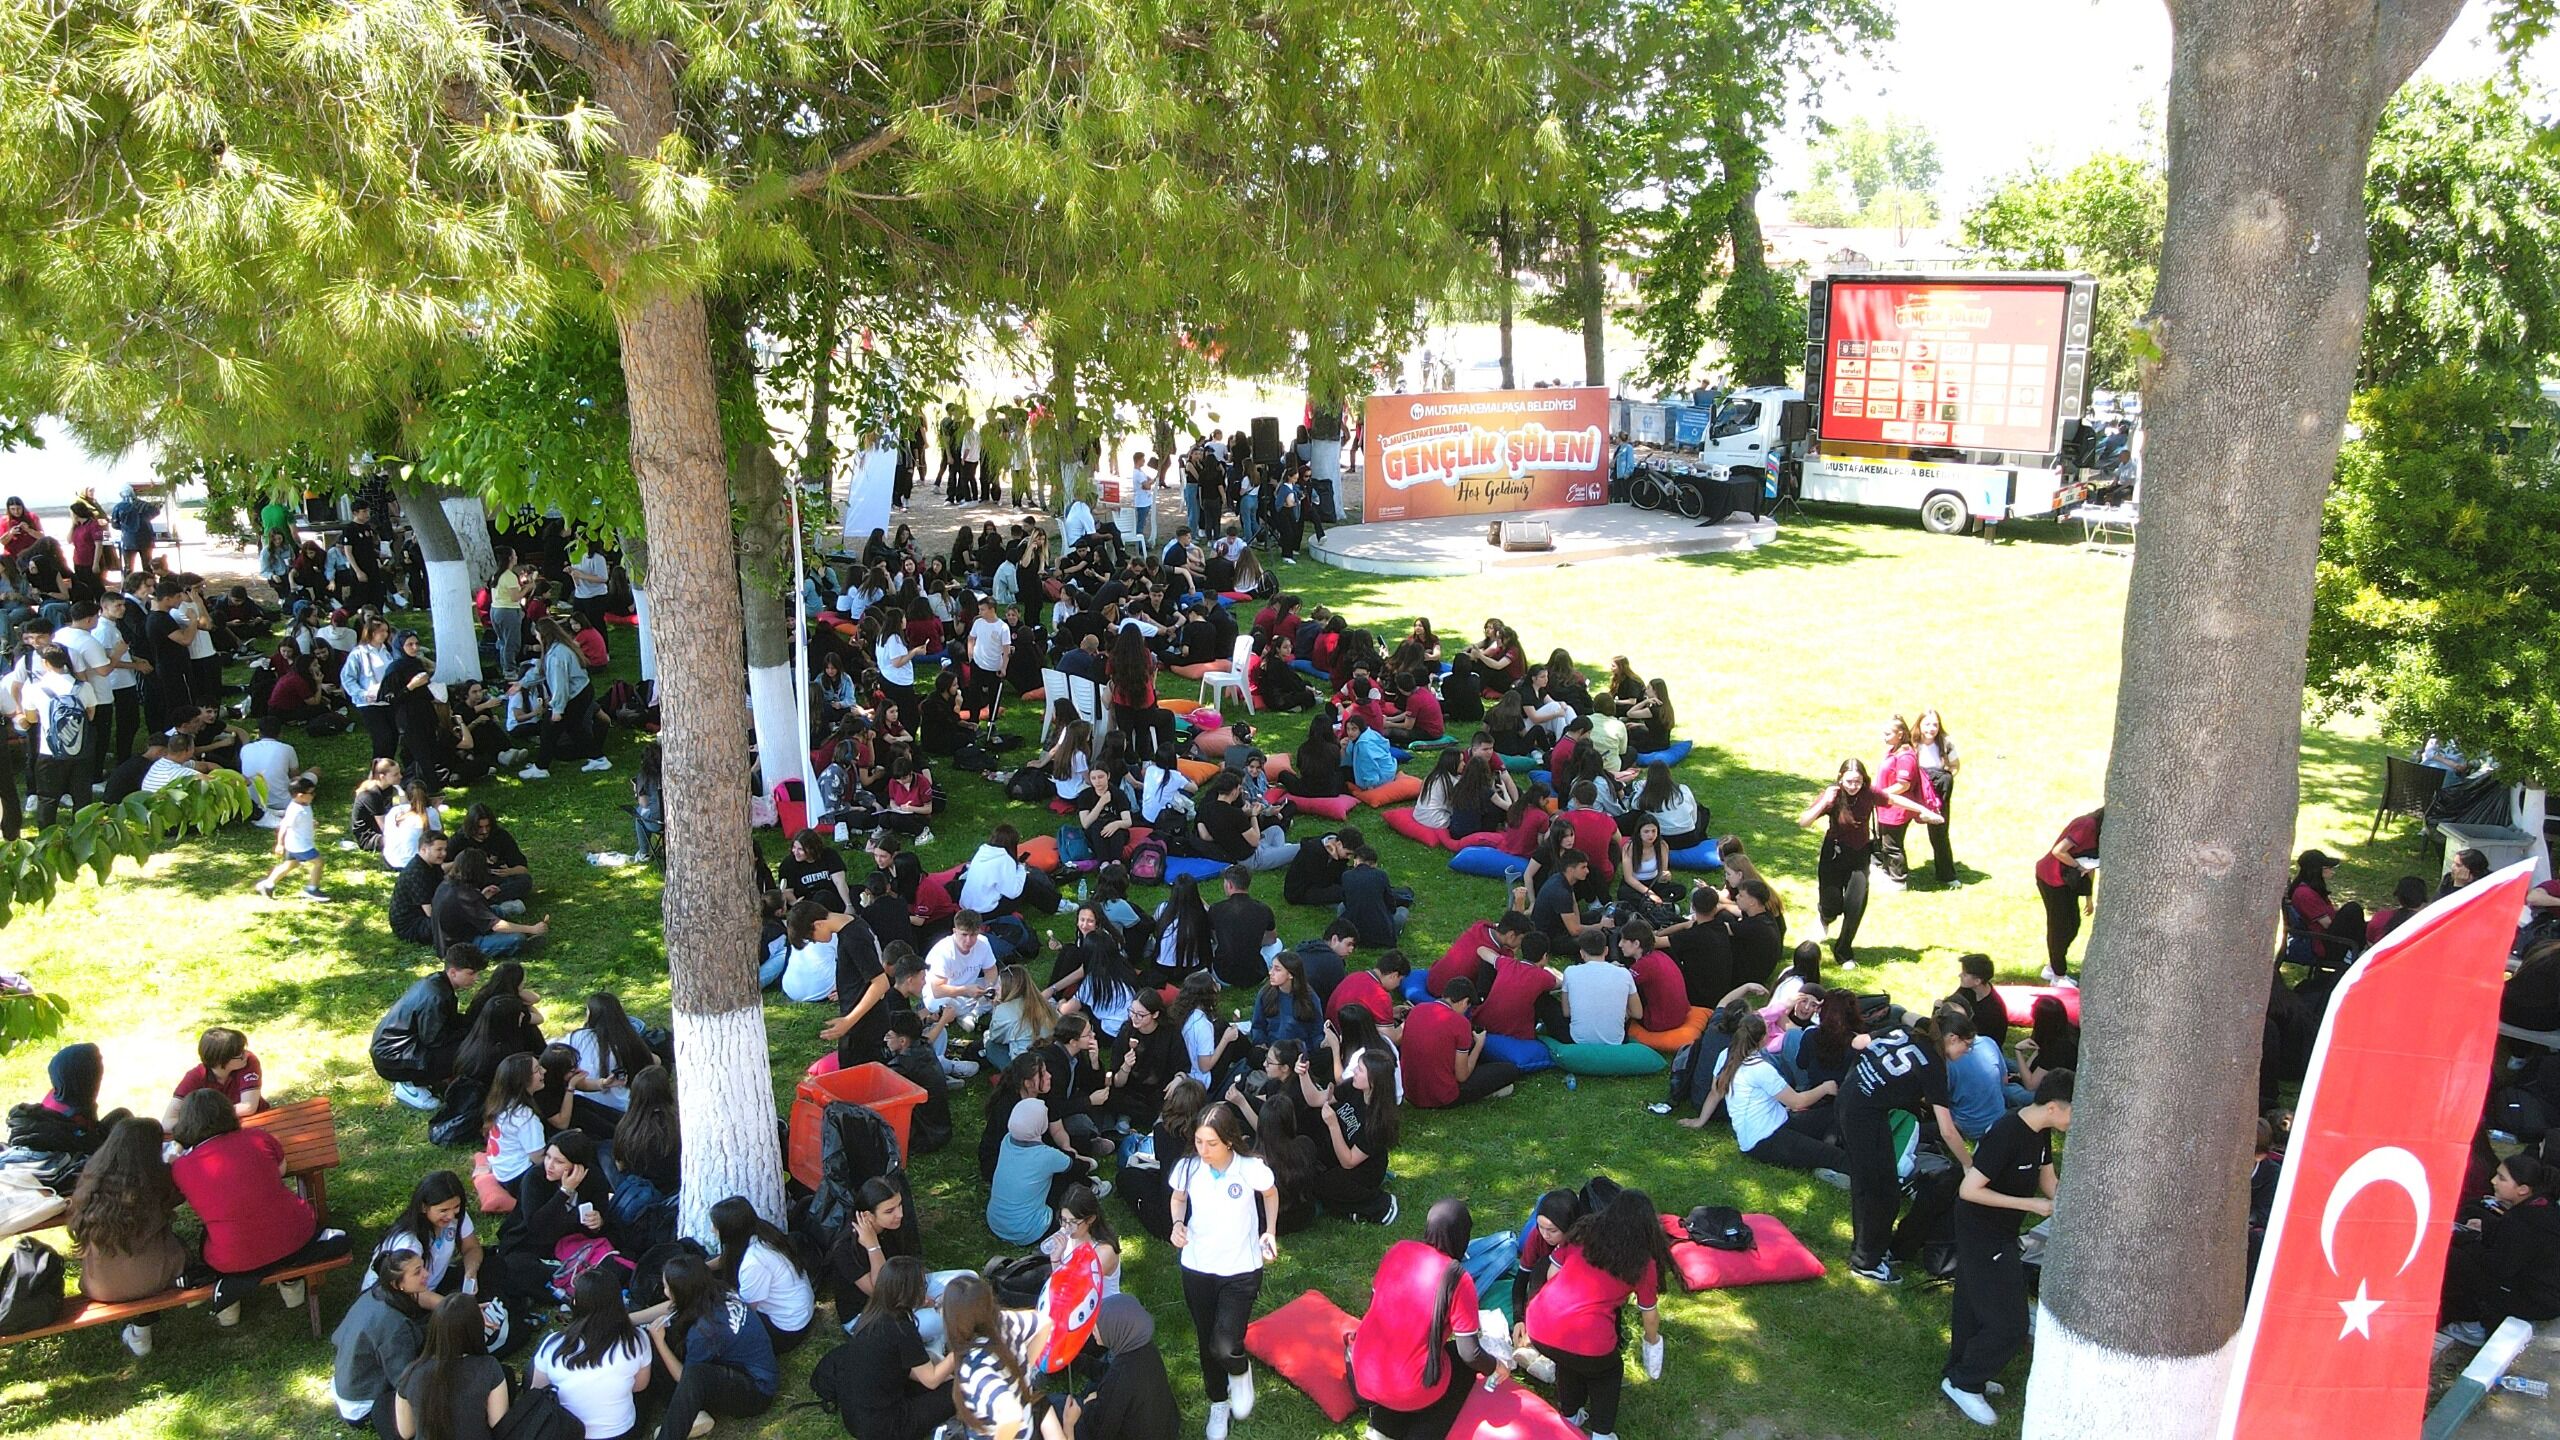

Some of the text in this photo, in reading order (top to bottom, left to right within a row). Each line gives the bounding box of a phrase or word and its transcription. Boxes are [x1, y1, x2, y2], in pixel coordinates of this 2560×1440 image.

[1424, 398, 1577, 417] MUSTAFAKEMALPAŞA BELEDİYESİ
[1385, 424, 1595, 480] GENÇLİK ŞÖLENİ
[1457, 480, 1530, 504] Hoş Geldiniz
[58, 718, 80, 746] NIKE
[1867, 1028, 1929, 1077] 25
